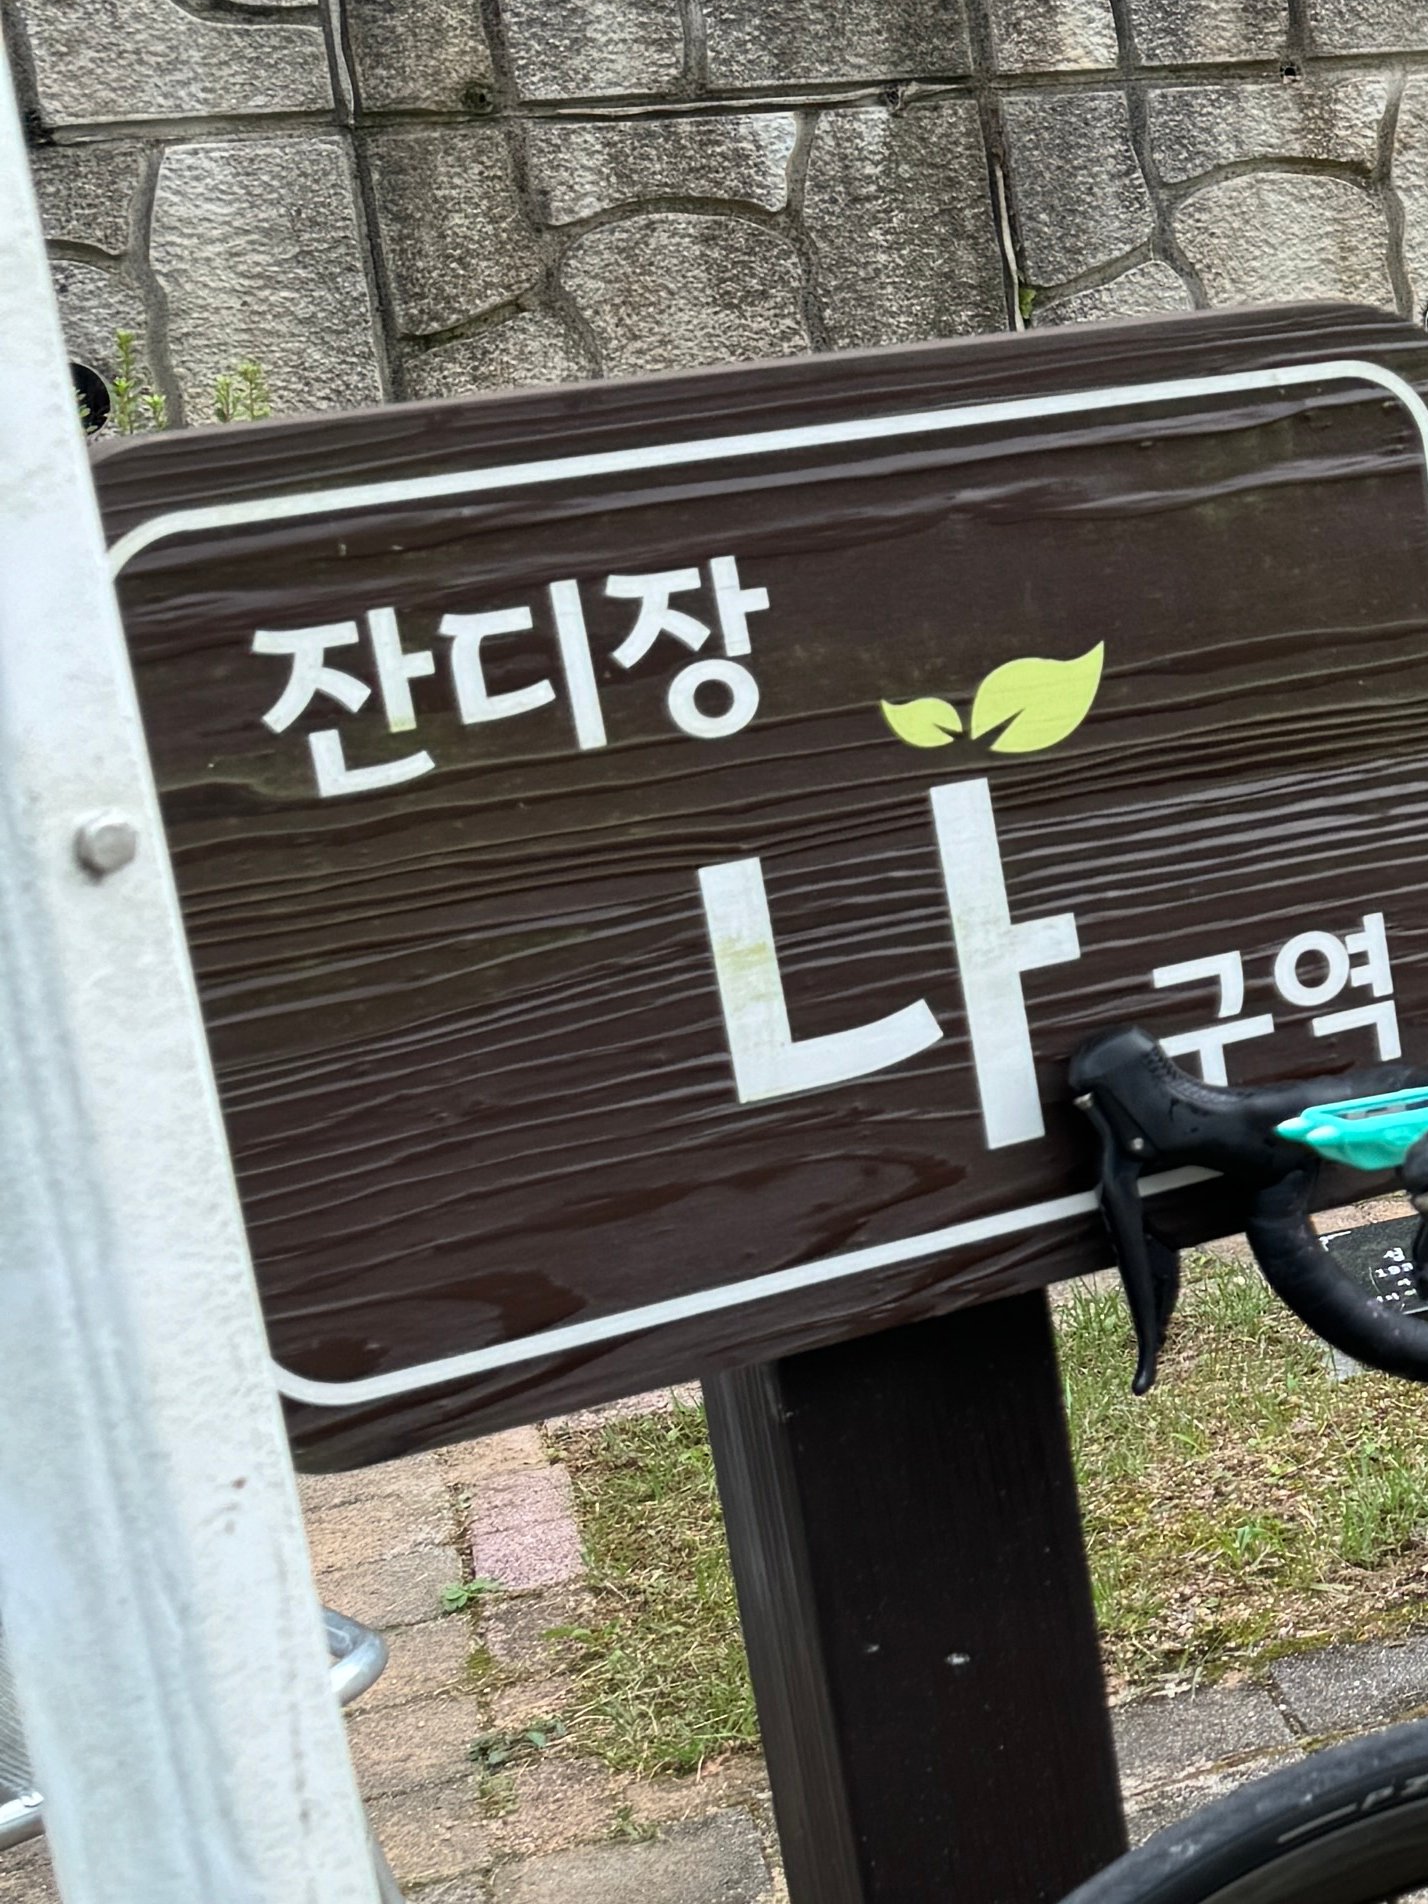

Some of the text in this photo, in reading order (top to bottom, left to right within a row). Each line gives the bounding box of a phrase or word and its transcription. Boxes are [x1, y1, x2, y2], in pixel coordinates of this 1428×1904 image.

[250, 554, 771, 799] 잔디장
[697, 776, 1403, 1151] 나 구역
